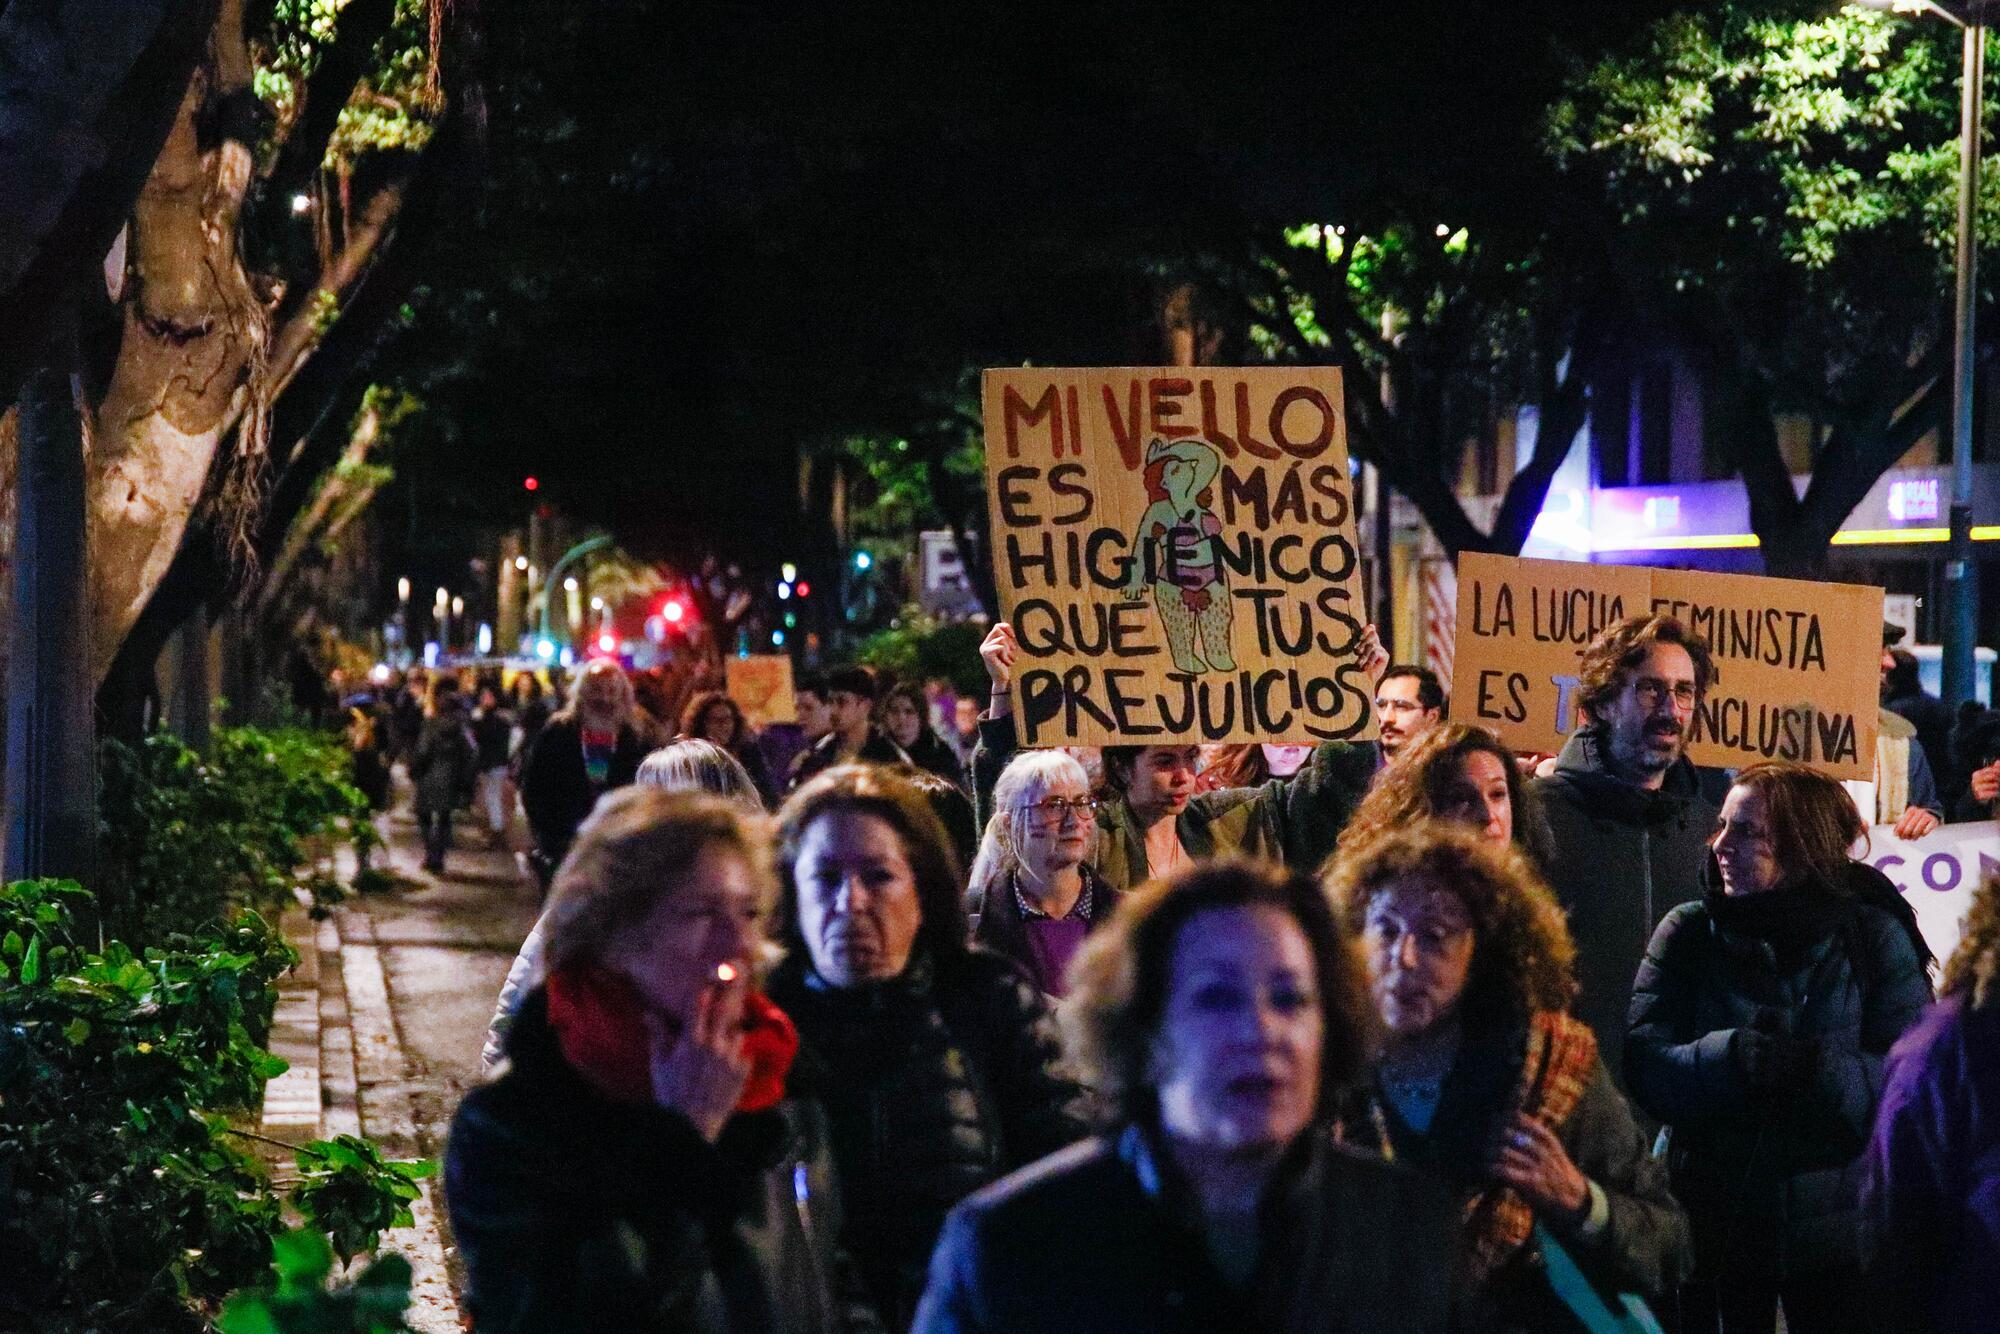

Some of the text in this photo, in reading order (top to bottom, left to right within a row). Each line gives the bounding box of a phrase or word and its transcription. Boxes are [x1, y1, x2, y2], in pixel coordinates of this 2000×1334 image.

[1003, 378, 1335, 471] MI VELLO
[998, 461, 1349, 531] ES MÁS
[1006, 509, 1357, 589] HIGIÉNICO
[1012, 587, 1362, 658] QUE TUS
[1473, 581, 1516, 637] LA
[1019, 663, 1371, 745] PREJUICIOS
[1477, 670, 1530, 723] ES
[1873, 852, 2000, 893] CO
